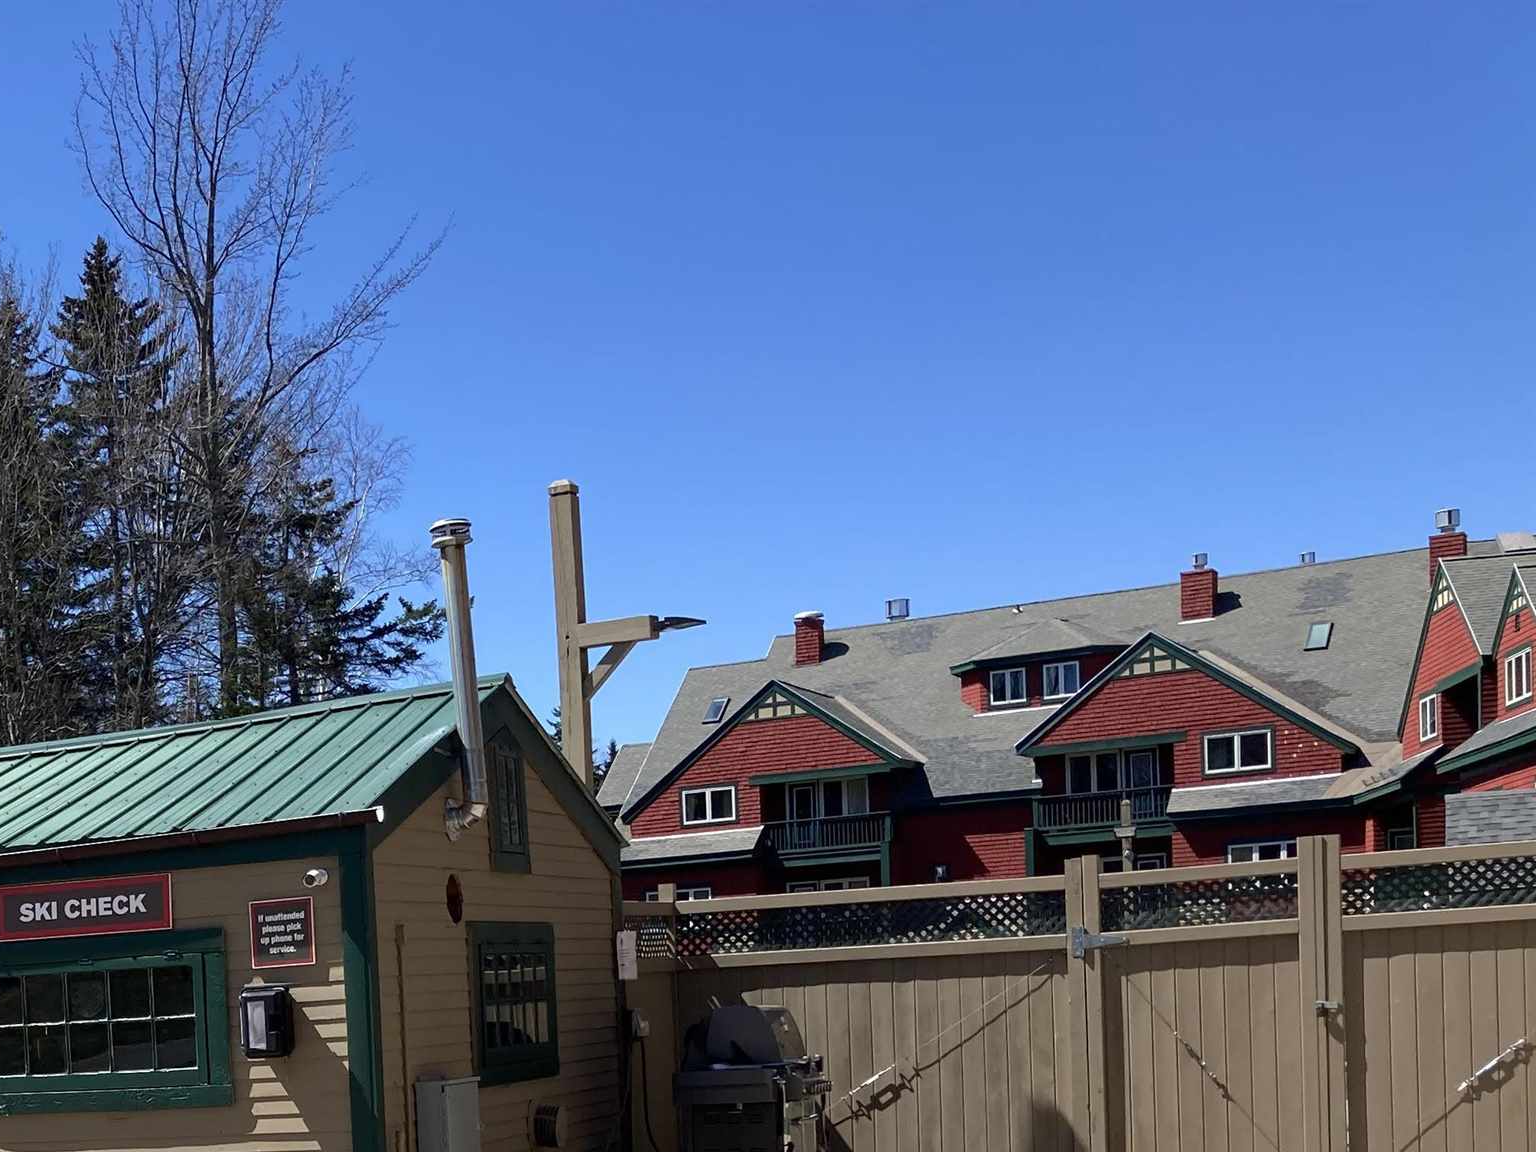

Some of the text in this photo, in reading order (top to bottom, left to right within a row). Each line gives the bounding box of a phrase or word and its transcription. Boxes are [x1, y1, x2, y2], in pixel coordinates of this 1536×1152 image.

[19, 893, 147, 922] SKI CHECK
[257, 911, 304, 923] If unattended
[262, 922, 302, 934] please pick
[260, 933, 304, 945] up phone for
[269, 945, 296, 954] service.
